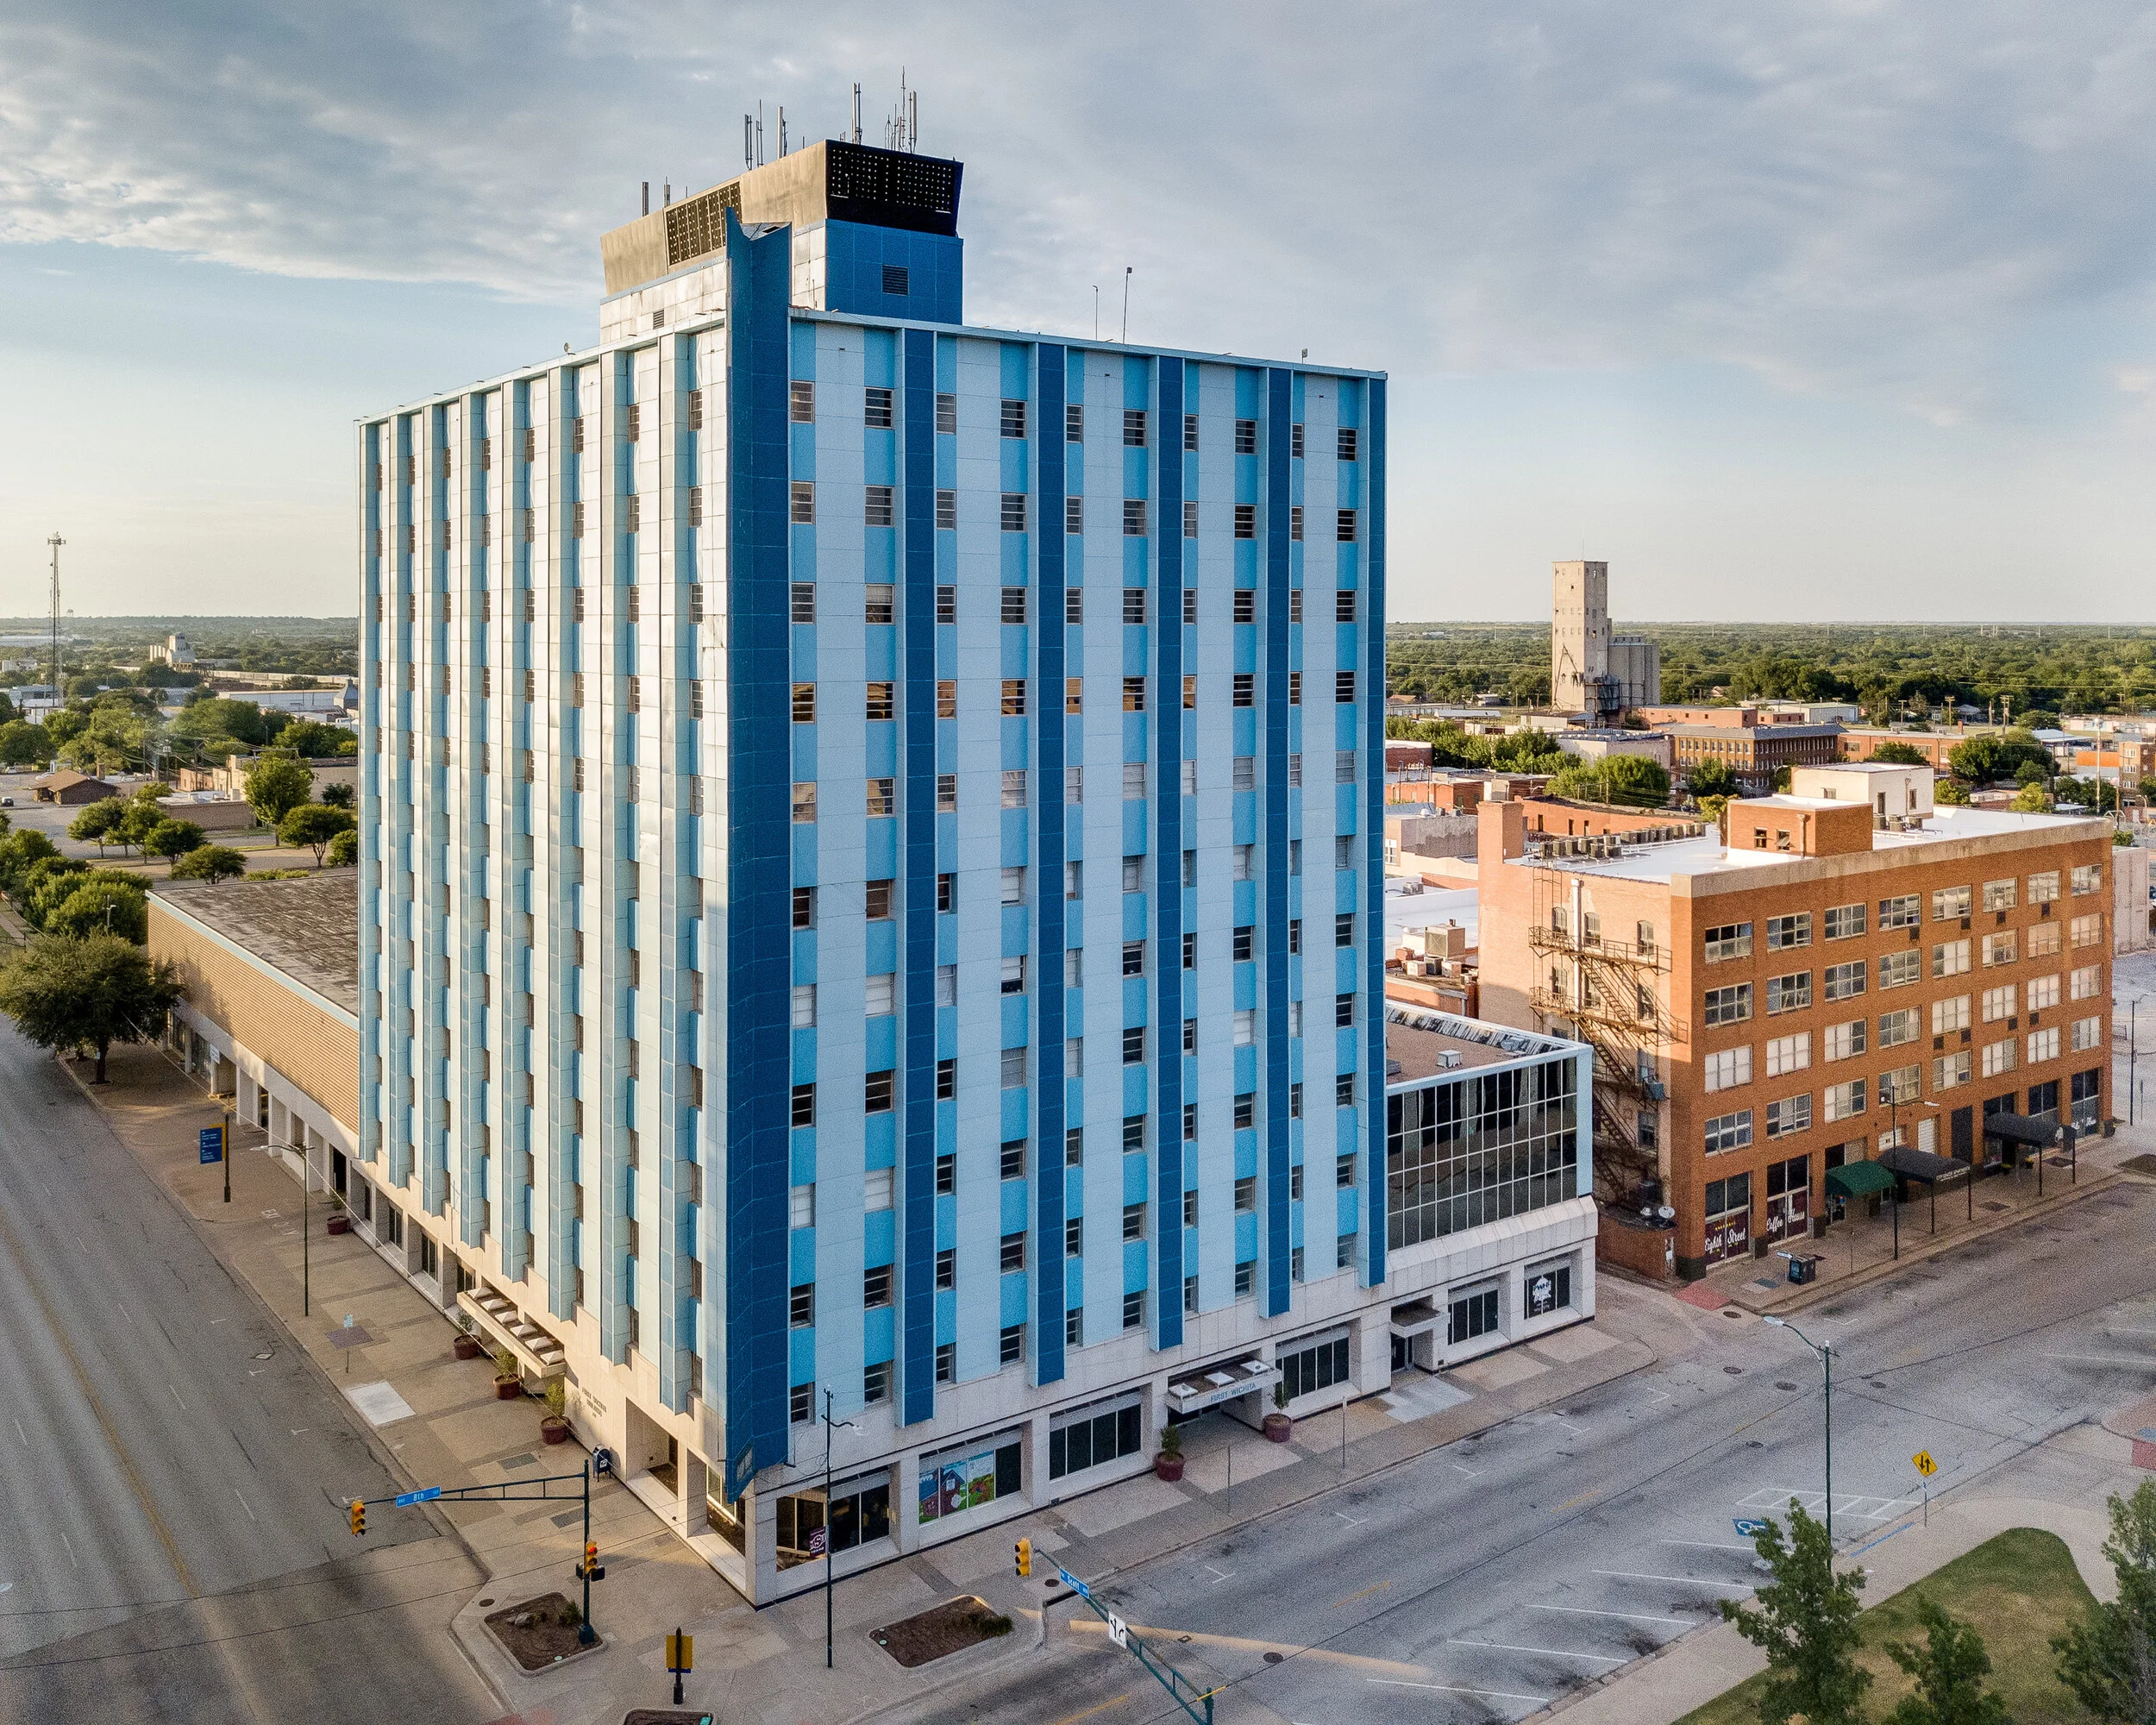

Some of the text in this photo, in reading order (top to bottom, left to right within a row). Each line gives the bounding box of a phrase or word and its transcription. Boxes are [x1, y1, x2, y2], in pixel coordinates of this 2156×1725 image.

[1727, 1227, 1746, 1244] Street
[1231, 1382, 1257, 1396] WICHITA
[1067, 1575, 1080, 1590] Scott
